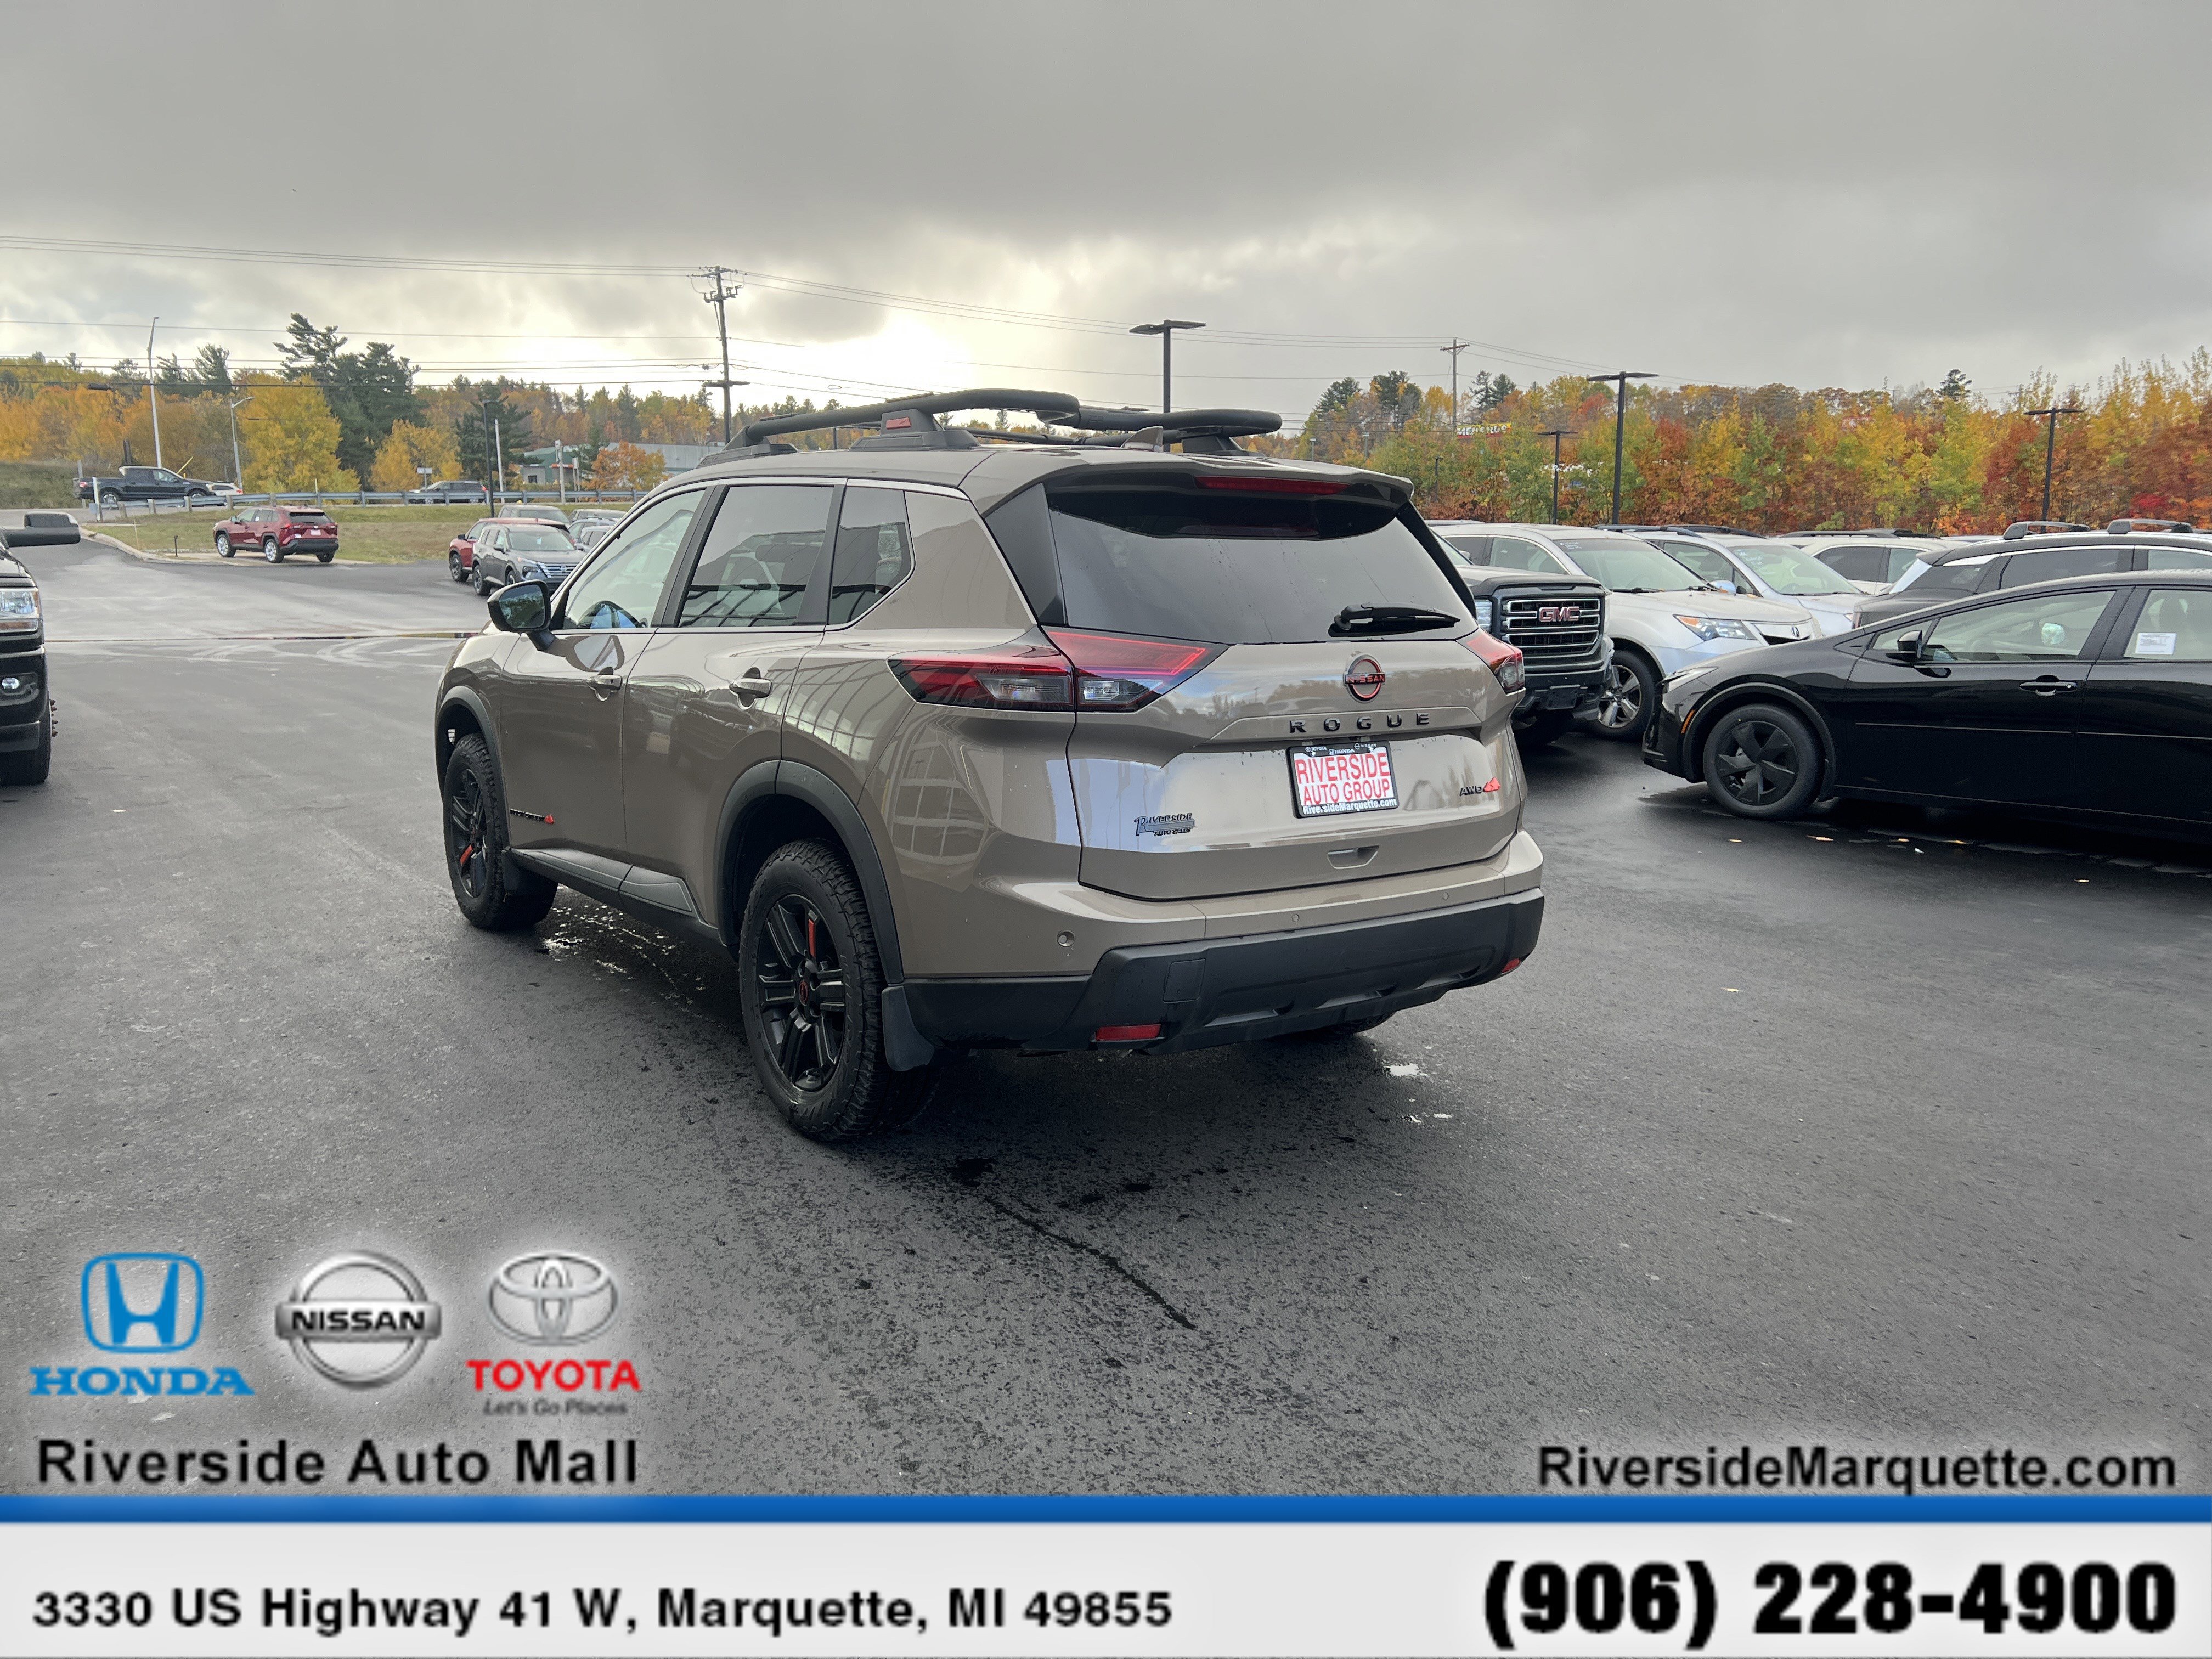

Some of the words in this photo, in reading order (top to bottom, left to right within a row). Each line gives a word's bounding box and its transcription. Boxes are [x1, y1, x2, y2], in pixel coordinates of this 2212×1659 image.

[1539, 606, 1579, 622] GMC
[1346, 675, 1385, 684] NISSAN
[1290, 713, 1429, 733] ROGUE
[1295, 753, 1390, 784] RIVERSIDE
[1304, 783, 1339, 805] AUTO
[1343, 778, 1390, 802] GROUP
[1459, 786, 1482, 797] AWD
